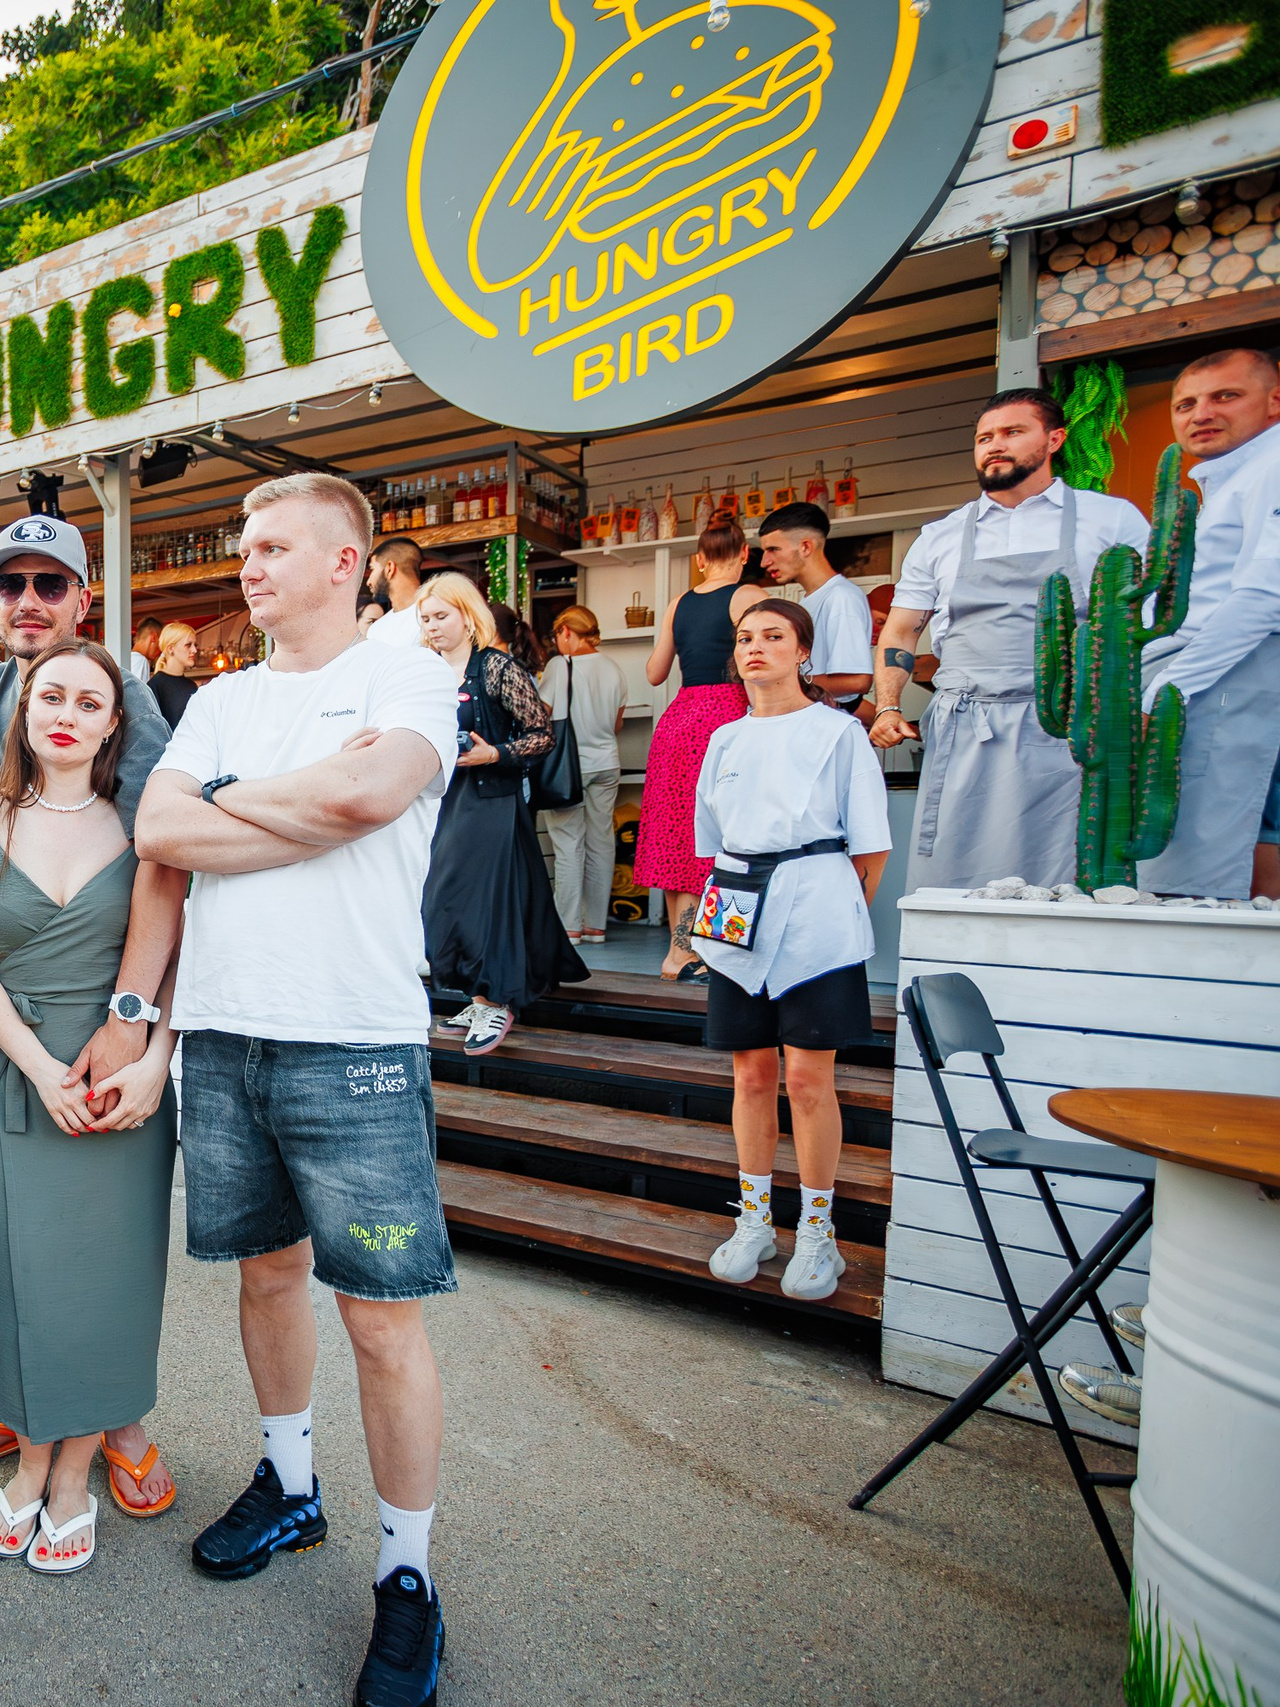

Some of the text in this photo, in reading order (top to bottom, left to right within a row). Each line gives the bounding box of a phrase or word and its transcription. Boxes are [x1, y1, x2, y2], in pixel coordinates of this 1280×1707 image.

[519, 148, 818, 337] HUNGRY
[573, 294, 735, 401] BIRD
[362, 1236, 408, 1251] YOU ARE
[375, 1222, 419, 1239] STRONG
